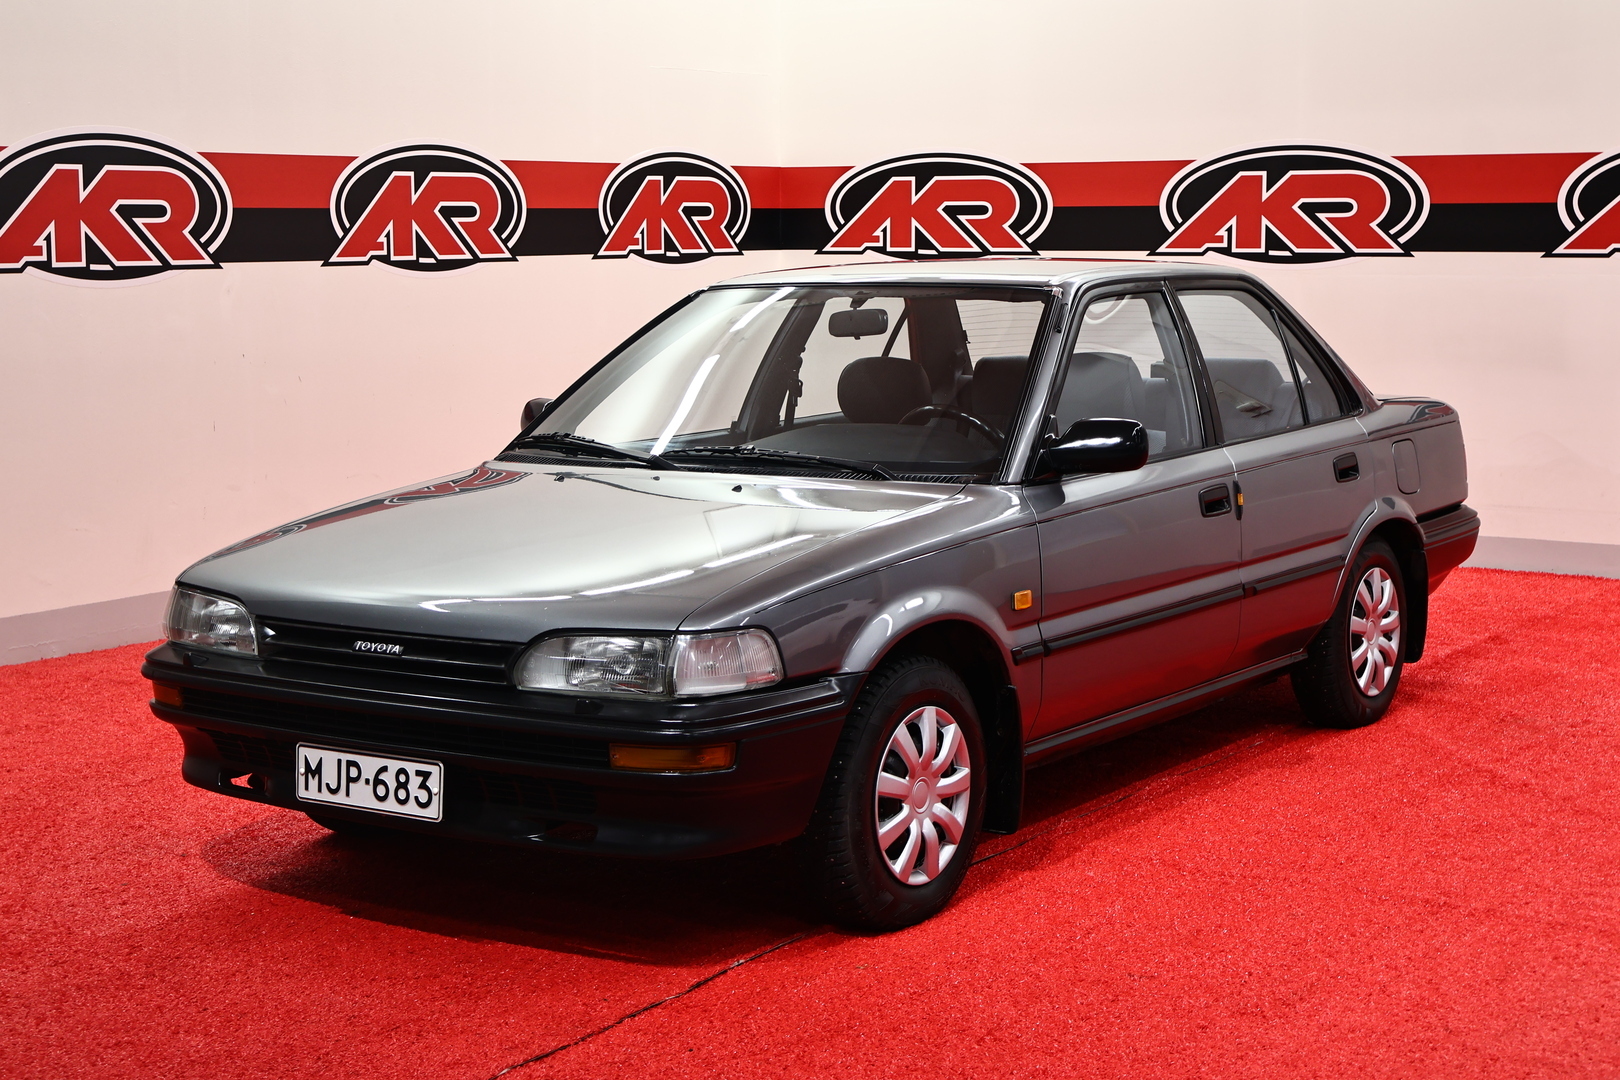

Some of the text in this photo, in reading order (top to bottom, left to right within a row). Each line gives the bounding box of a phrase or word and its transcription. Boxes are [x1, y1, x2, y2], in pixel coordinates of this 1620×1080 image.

[0, 163, 215, 268] AKR
[329, 171, 514, 260] AKR
[597, 175, 741, 254] AKR
[823, 175, 1034, 253] AKR
[1155, 169, 1408, 254] AKR
[354, 640, 401, 655] TOYOTA
[304, 754, 433, 809] MJP-683
